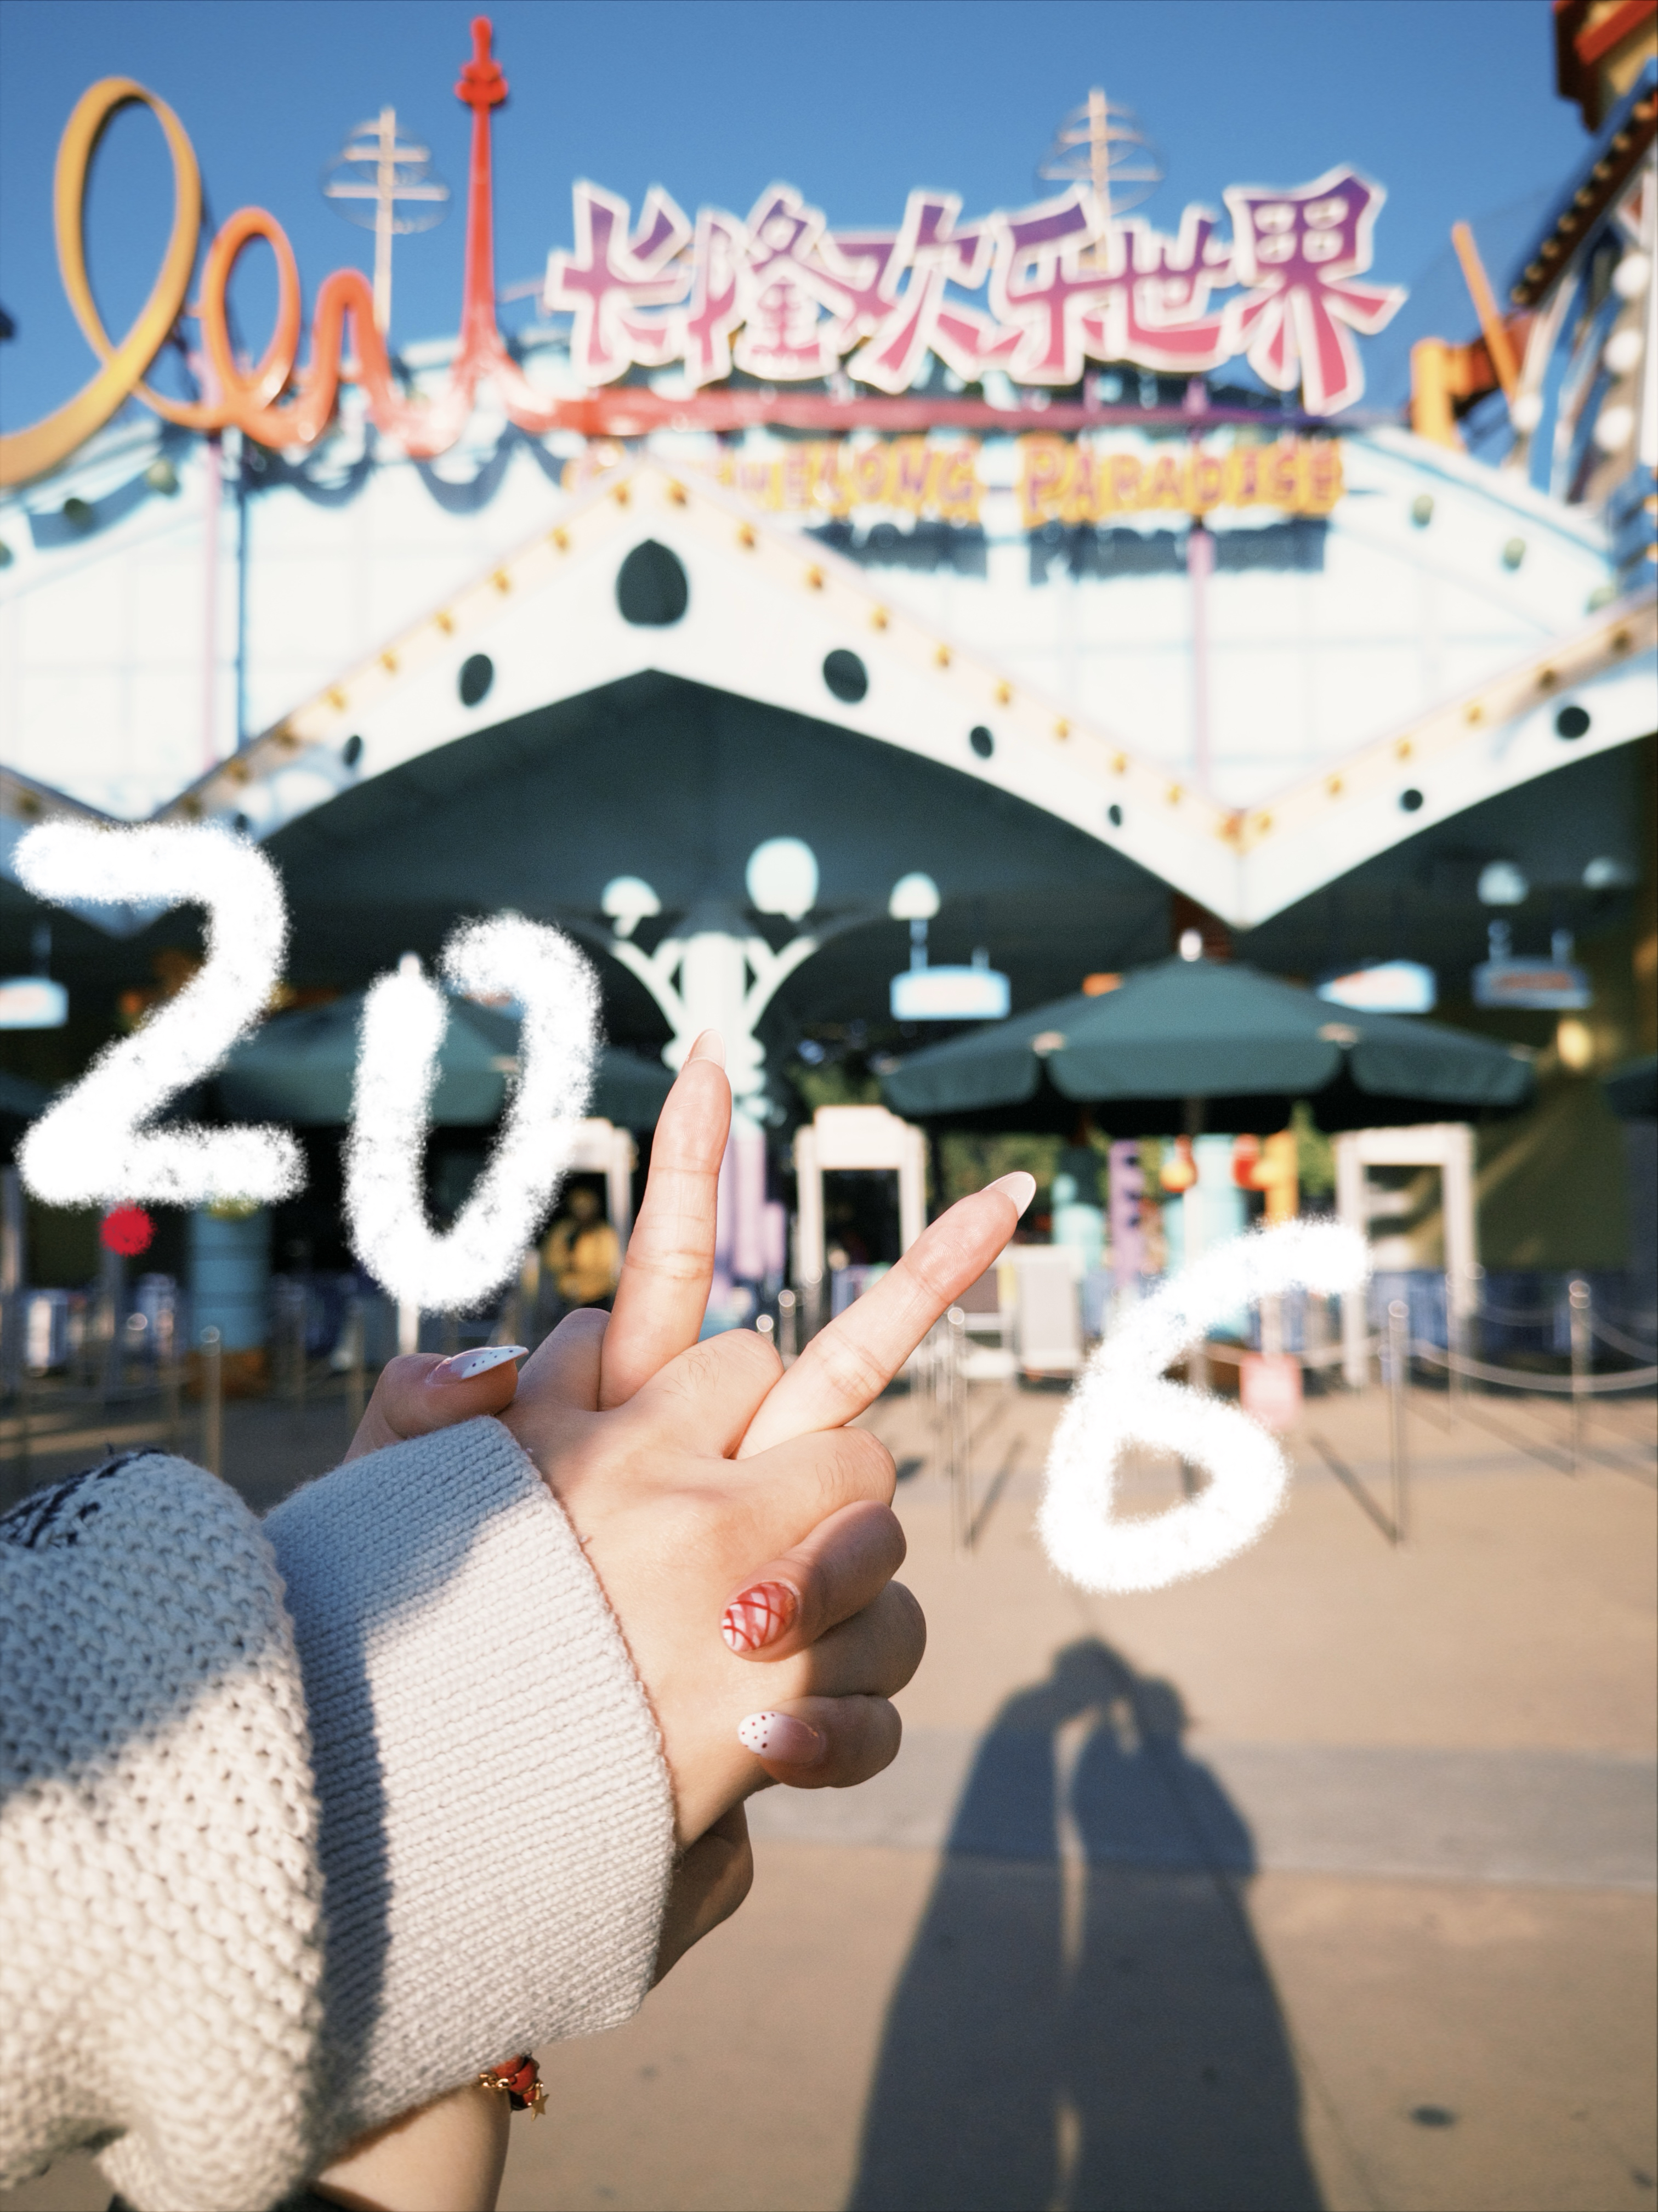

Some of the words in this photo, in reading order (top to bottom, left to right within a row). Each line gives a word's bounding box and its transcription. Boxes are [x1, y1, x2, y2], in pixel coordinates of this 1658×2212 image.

[545, 166, 1409, 415] 长隆欢乐世界
[1020, 435, 1344, 522] PARADISE
